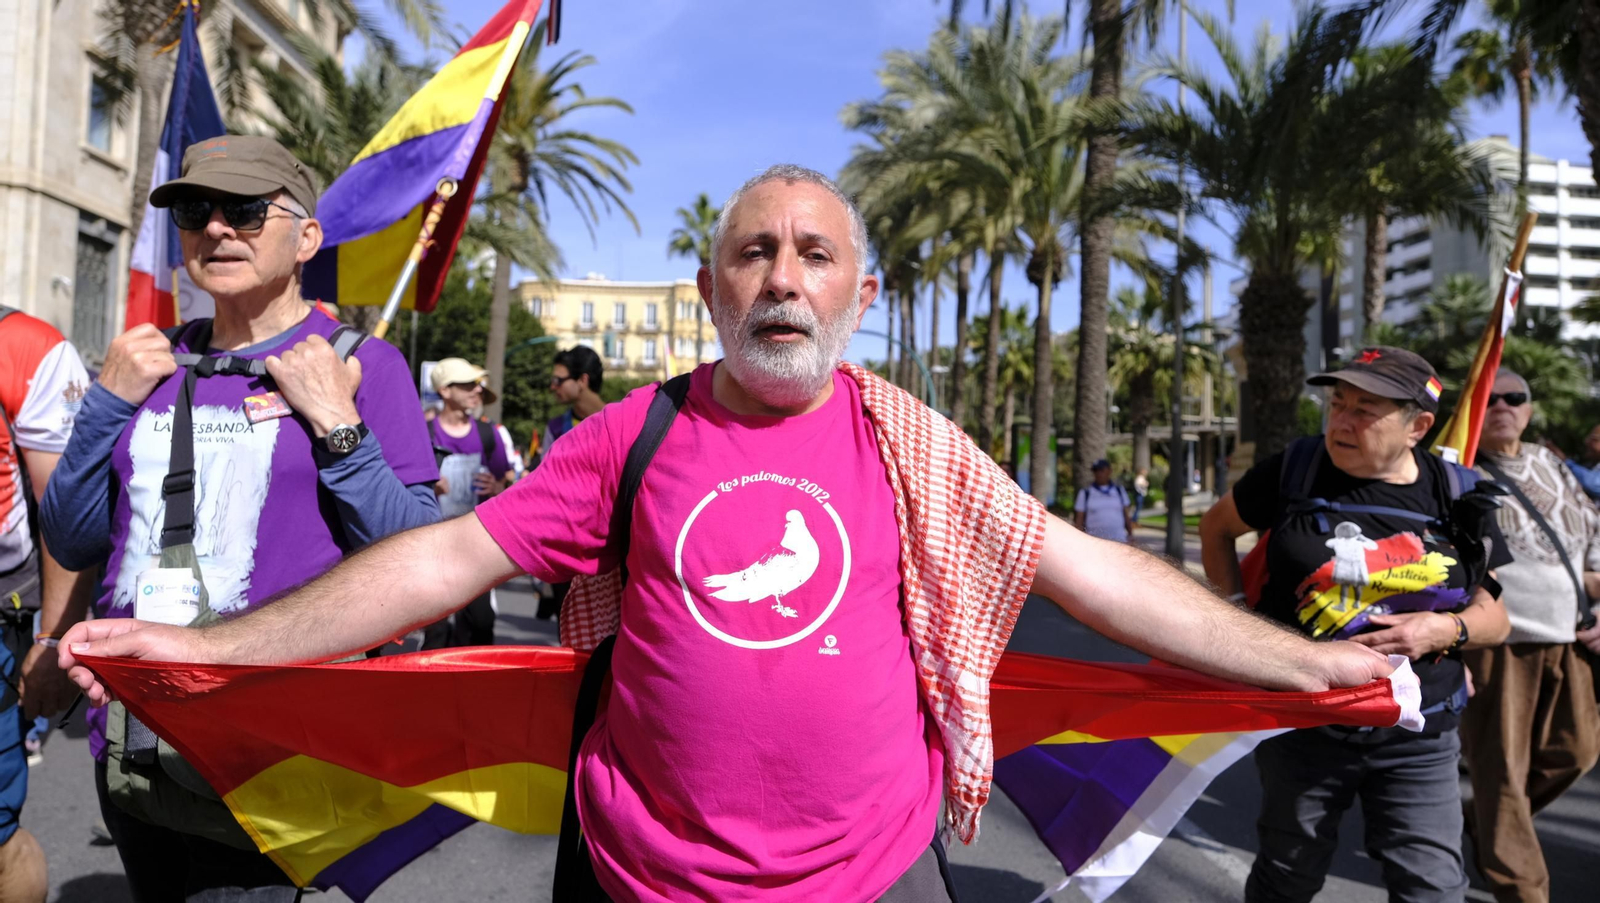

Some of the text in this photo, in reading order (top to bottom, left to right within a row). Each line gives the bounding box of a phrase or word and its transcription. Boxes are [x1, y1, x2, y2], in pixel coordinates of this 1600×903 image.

[154, 421, 254, 434] LA ESBANDA
[717, 470, 831, 504] Los palomos 2012
[1385, 552, 1428, 566] Verdad
[1382, 567, 1429, 582] Justicia
